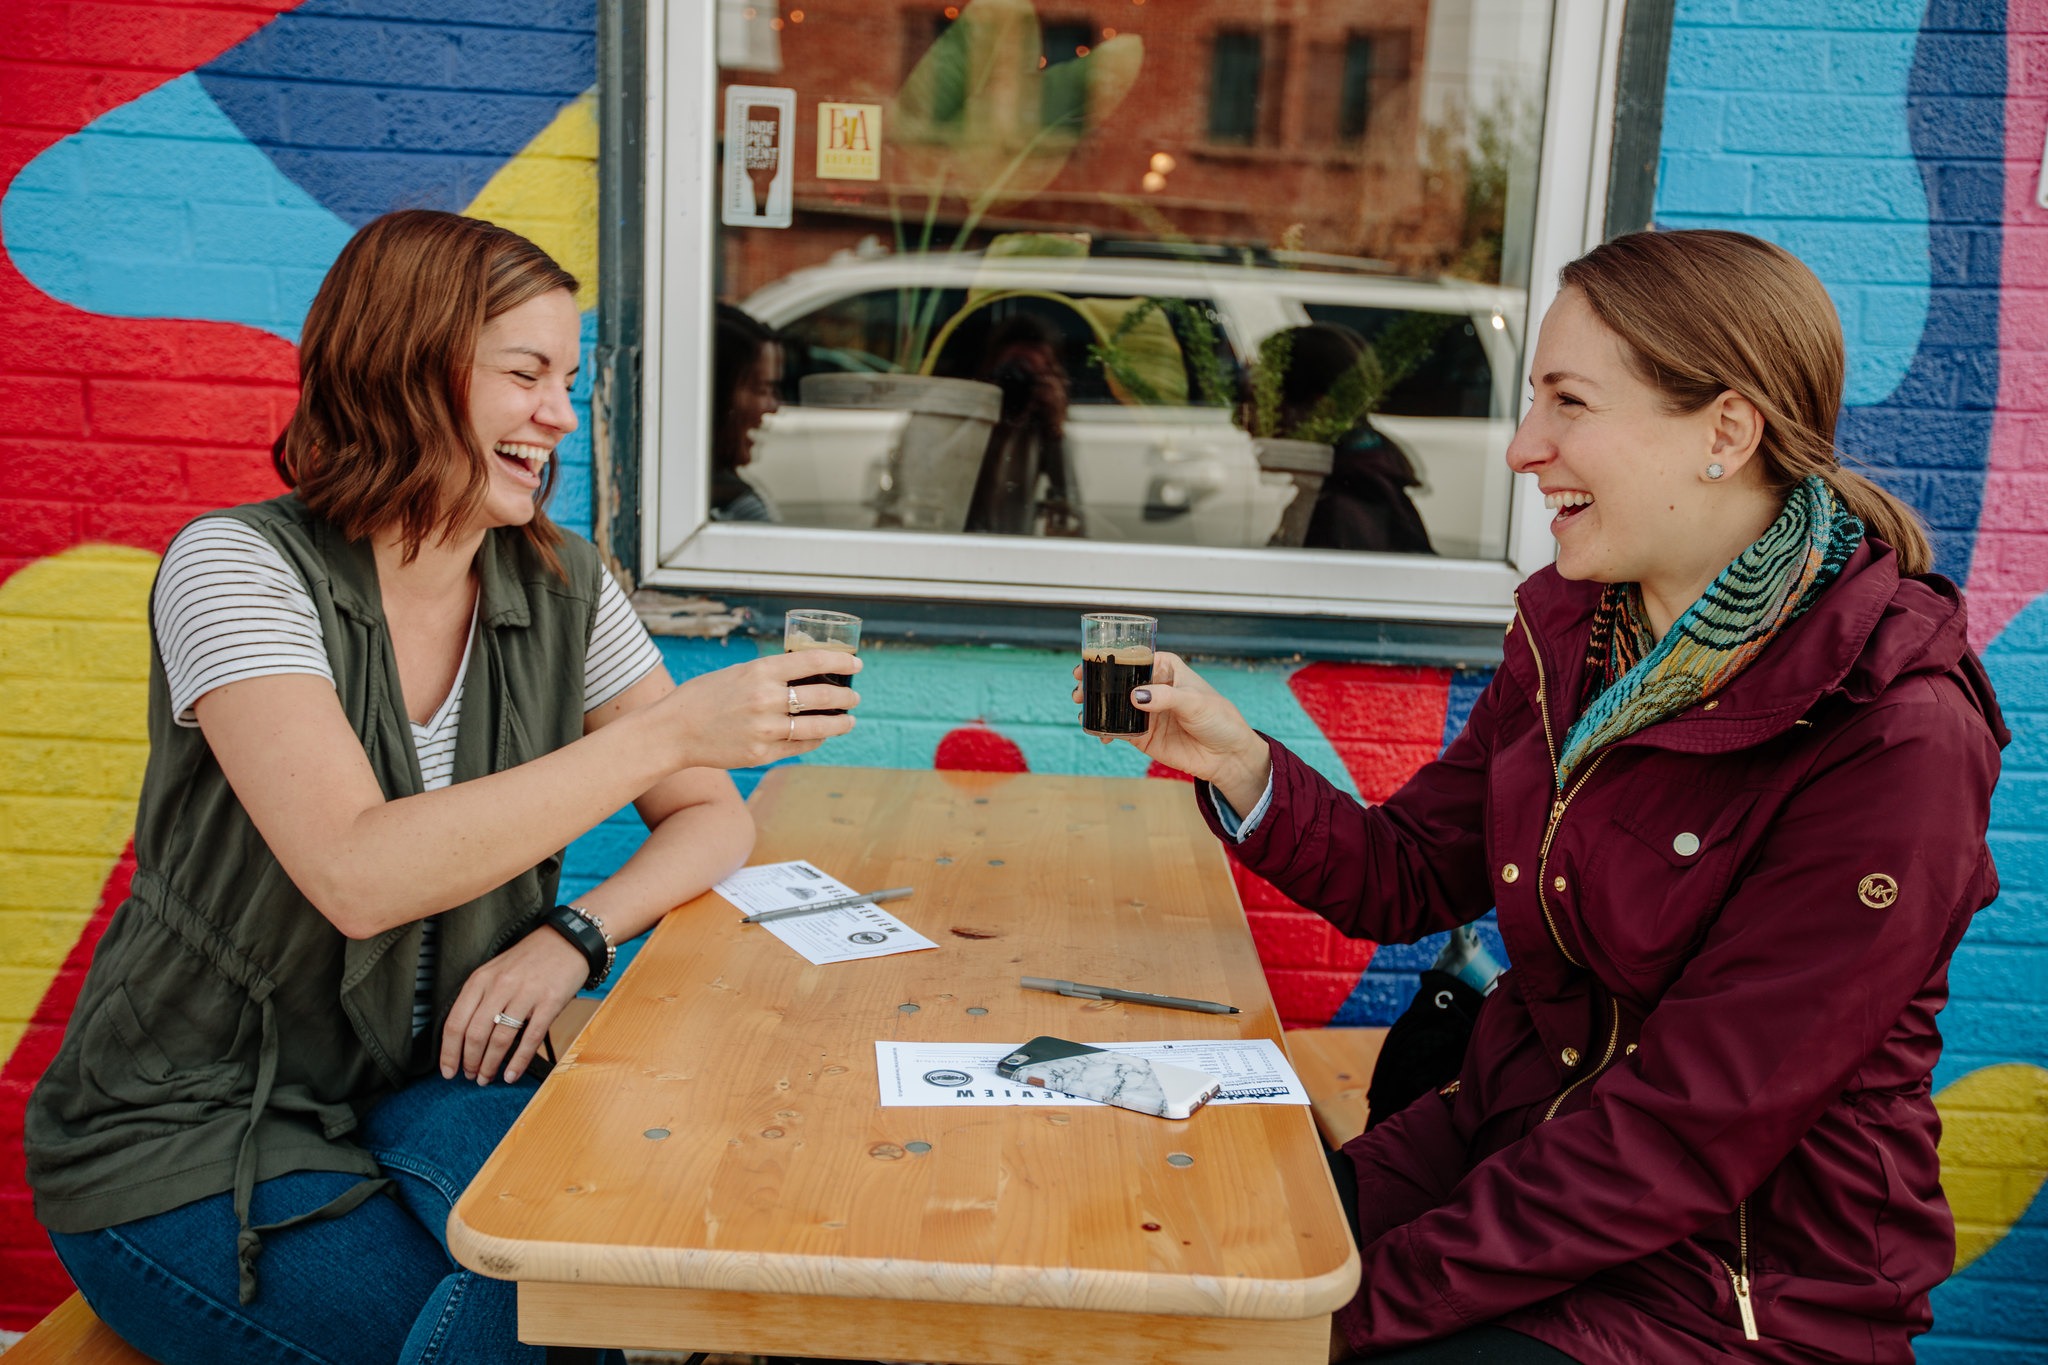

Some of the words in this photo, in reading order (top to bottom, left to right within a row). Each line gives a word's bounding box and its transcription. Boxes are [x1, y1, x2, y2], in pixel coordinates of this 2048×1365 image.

[746, 121, 777, 134] INDE
[746, 134, 772, 147] PEN
[745, 147, 779, 160] DENT
[1860, 878, 1895, 903] MK
